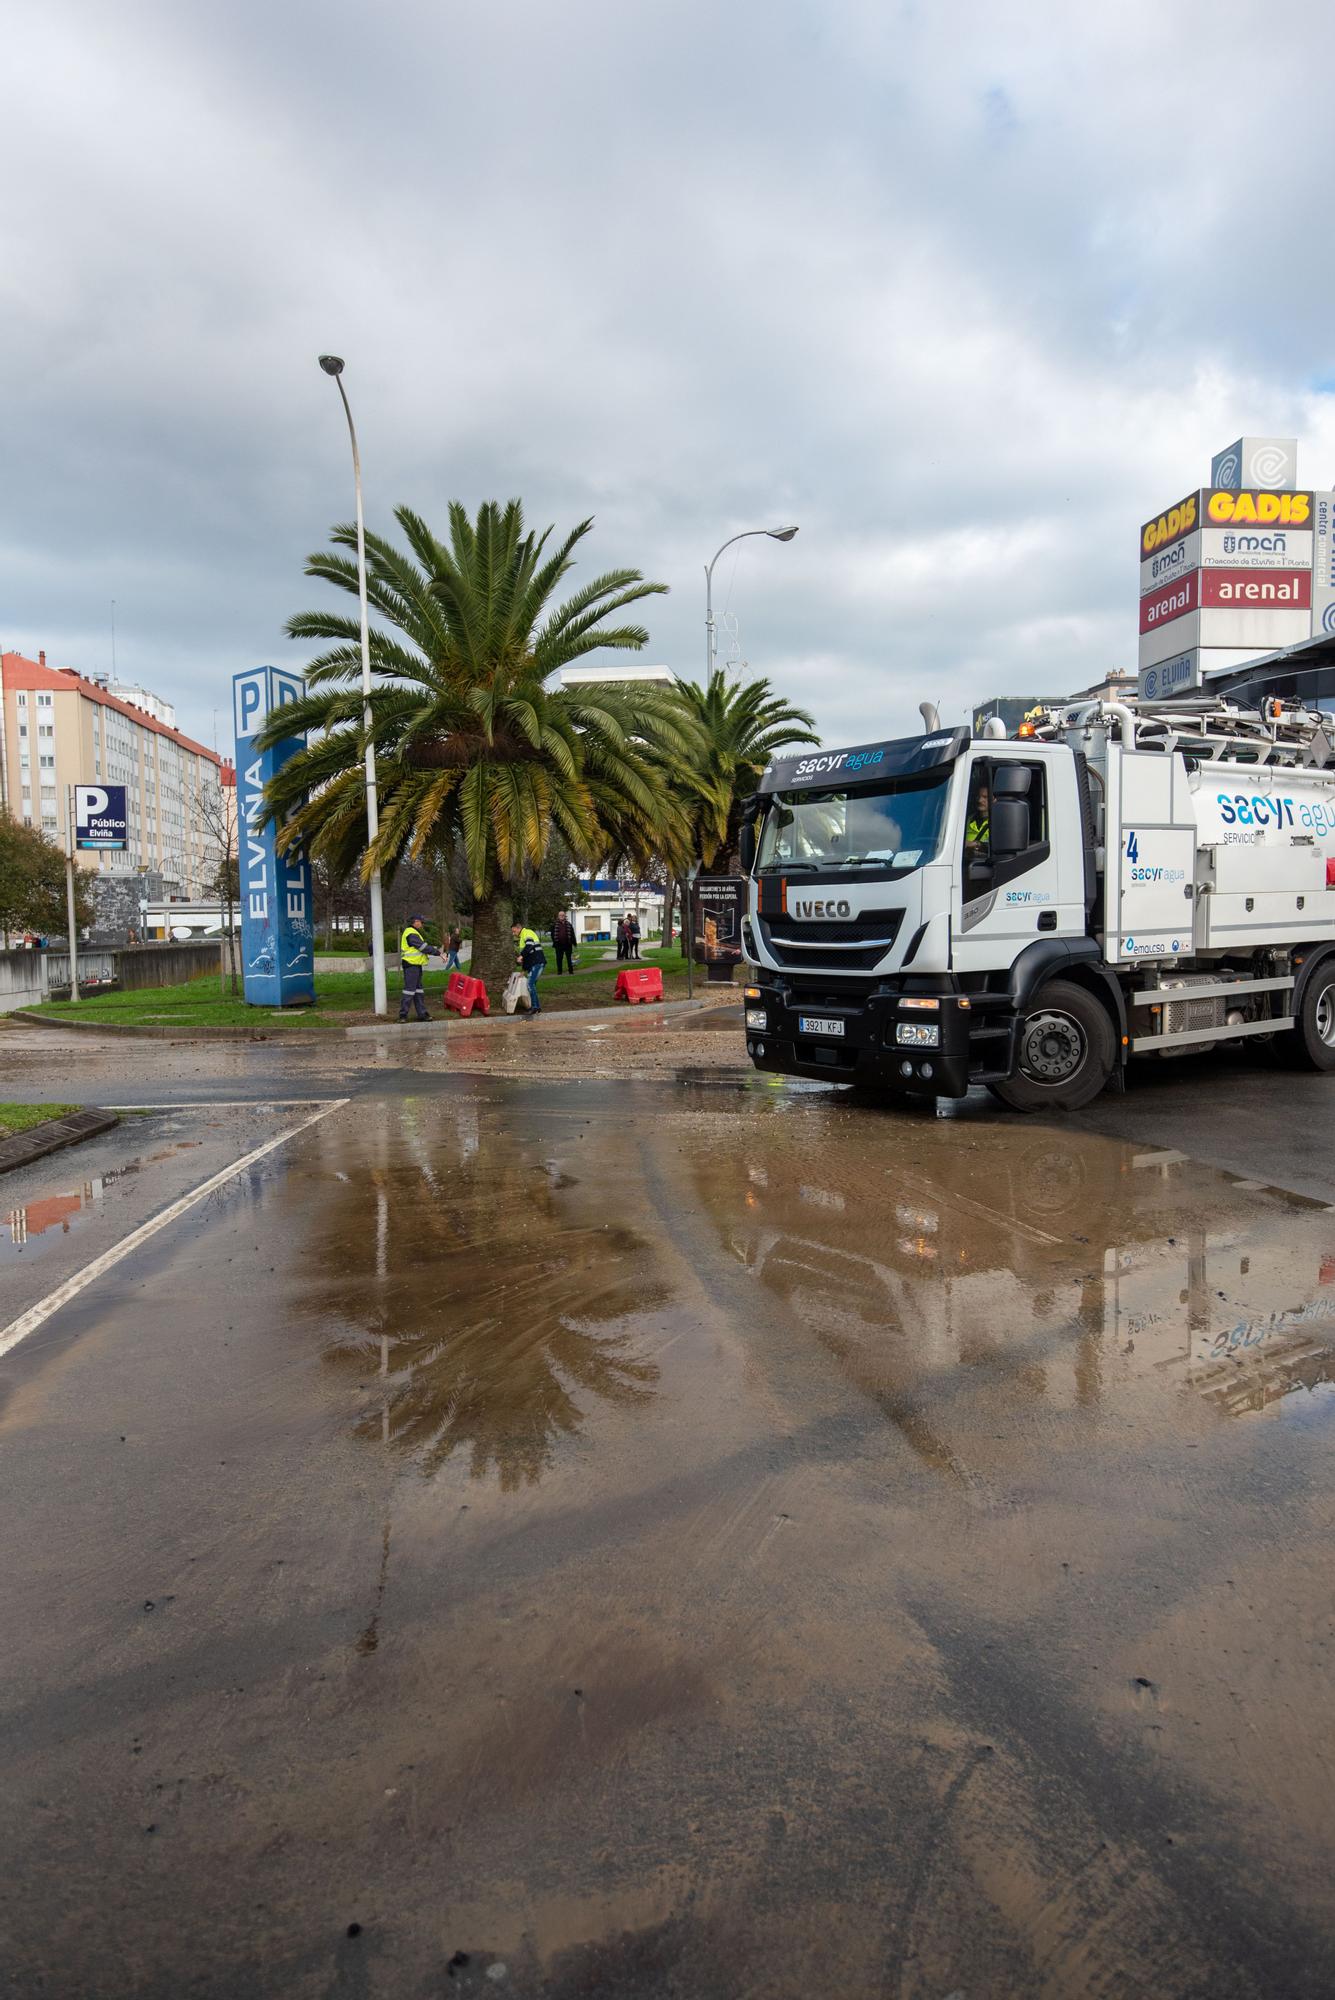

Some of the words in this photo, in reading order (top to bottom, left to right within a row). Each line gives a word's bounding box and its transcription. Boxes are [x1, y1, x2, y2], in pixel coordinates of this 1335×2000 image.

[1208, 492, 1310, 524] GADIS
[1143, 497, 1196, 553] GADIS
[1219, 578, 1299, 600] arenal
[1147, 582, 1190, 623] arenal
[795, 753, 848, 775] sacyr
[845, 750, 884, 771] agua
[91, 818, 126, 828] Público
[1217, 794, 1294, 830] sacyr
[89, 829, 113, 837] Elviña
[241, 757, 269, 919] ELVIÑA
[1126, 831, 1139, 864] 4
[1131, 868, 1163, 882] sacyr
[1163, 869, 1185, 883] agua
[1006, 892, 1032, 902] sacyr
[796, 900, 851, 918] IVECO
[805, 1019, 823, 1032] 3921
[827, 1021, 843, 1034] KFJ
